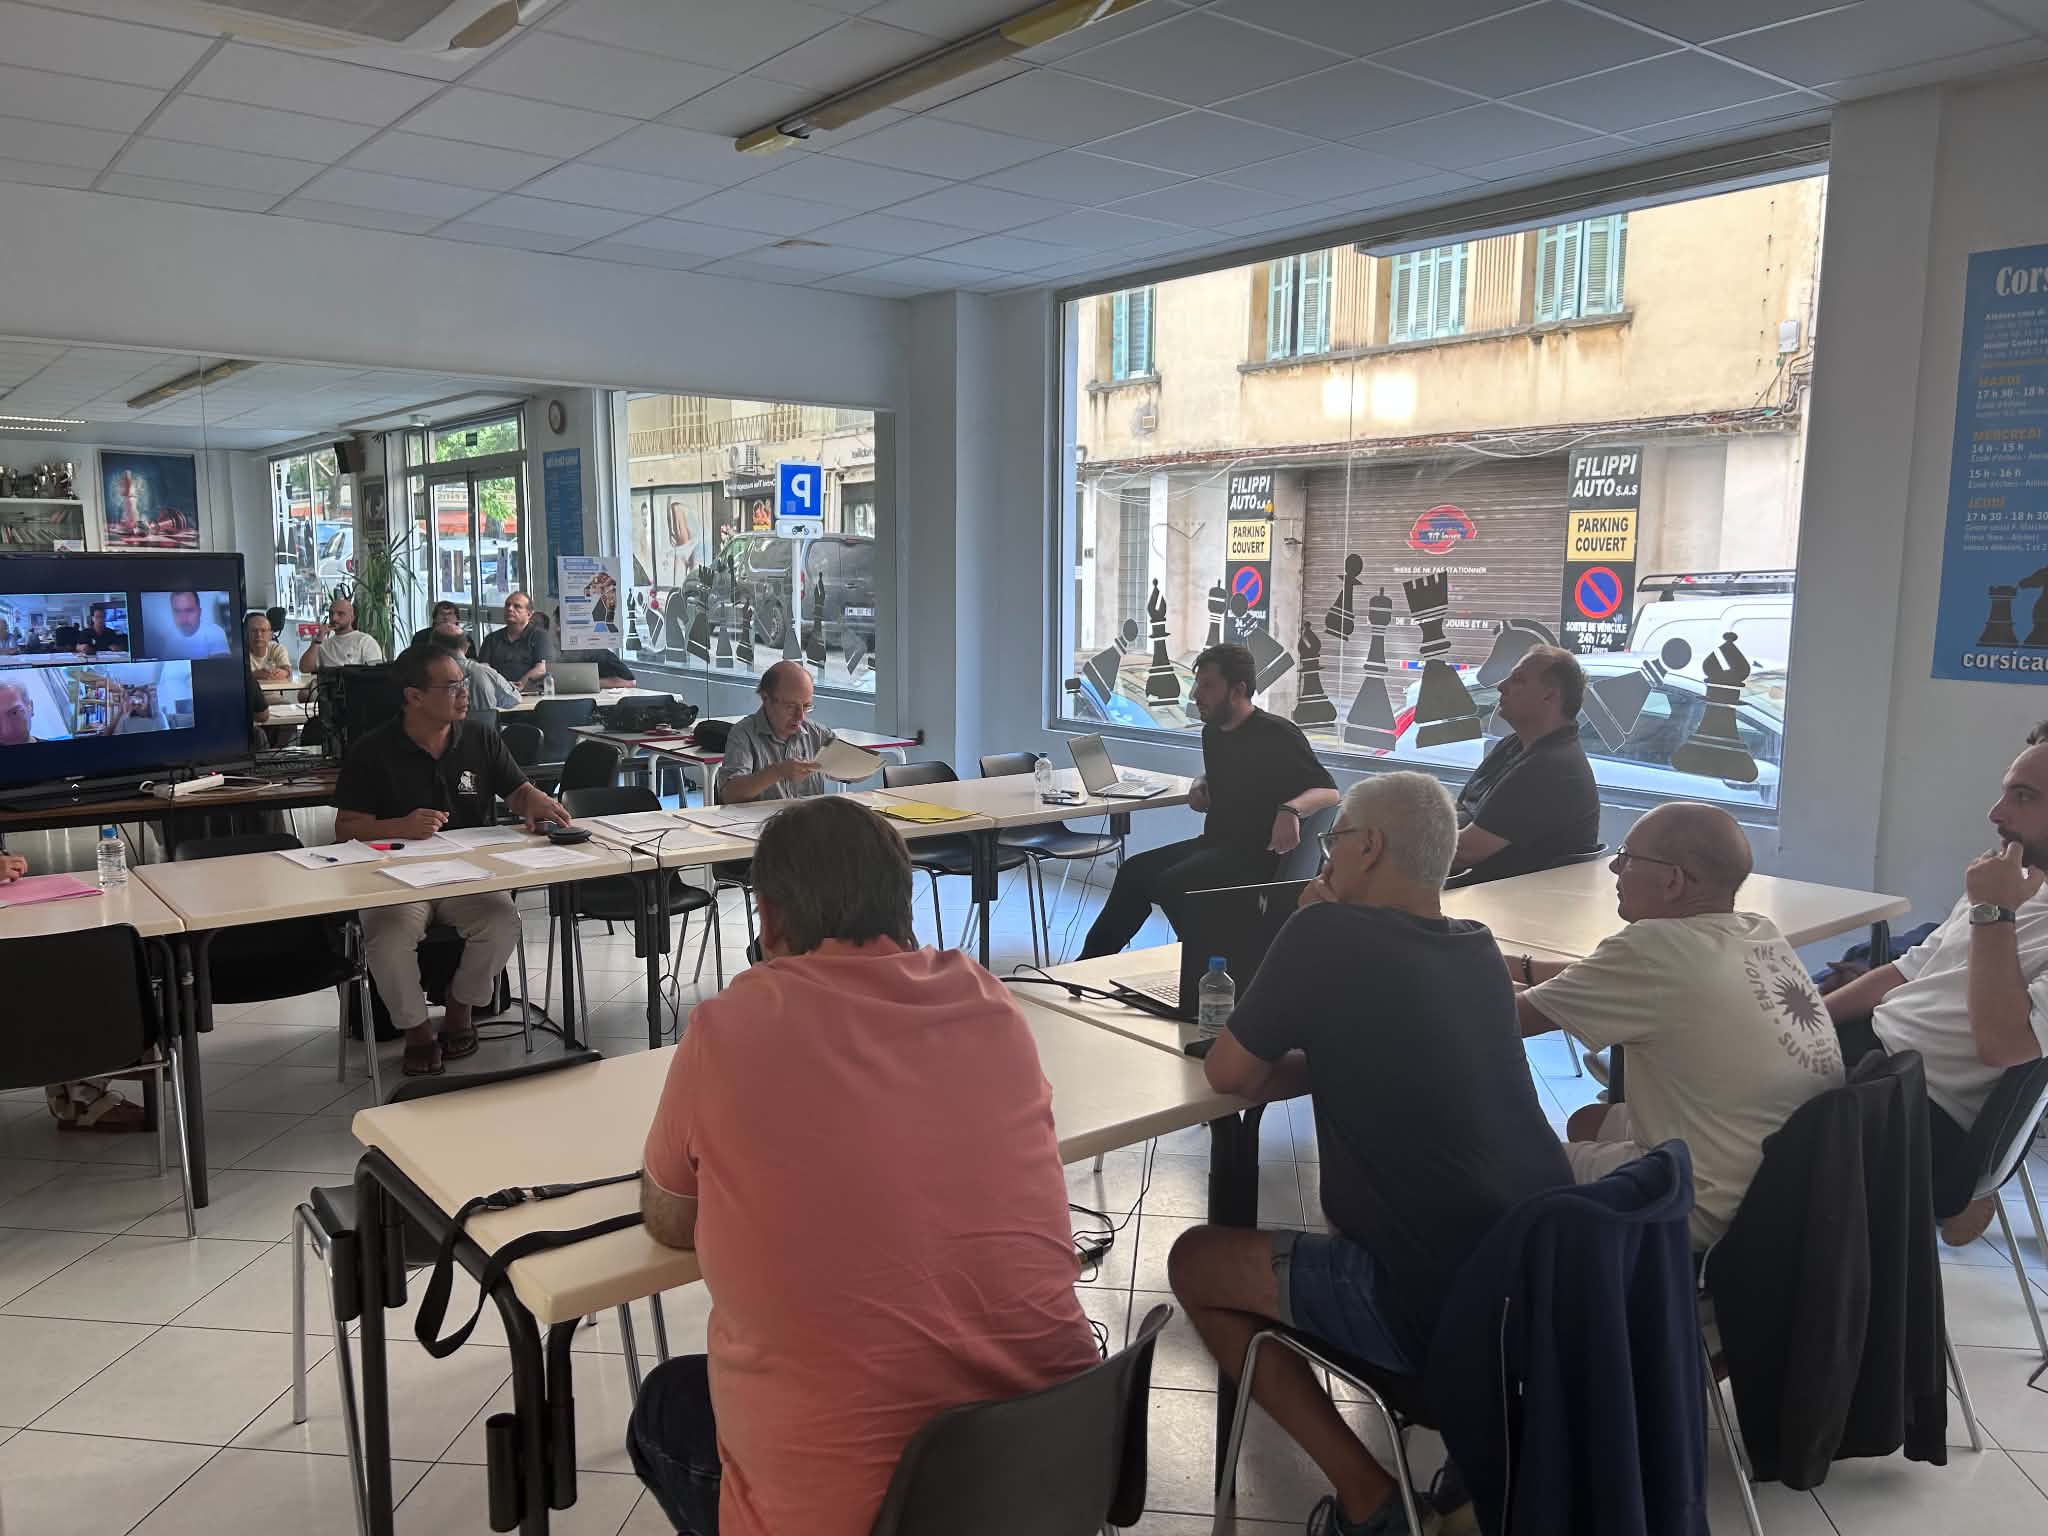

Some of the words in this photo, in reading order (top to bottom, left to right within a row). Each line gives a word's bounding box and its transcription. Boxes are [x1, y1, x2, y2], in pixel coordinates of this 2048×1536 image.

[1574, 453, 1638, 478] FILIPPI
[1231, 474, 1271, 494] FILIPPI
[1572, 479, 1615, 498] AUTO
[1230, 495, 1257, 510] AUTO
[1233, 526, 1266, 538] PARKING
[1577, 517, 1628, 533] PARKING
[1232, 541, 1265, 554] COUVERT
[1575, 537, 1627, 552] COUVERT
[1446, 566, 1487, 575] STATIONNER
[1962, 650, 2048, 671] corsica
[1752, 945, 1777, 961] THE
